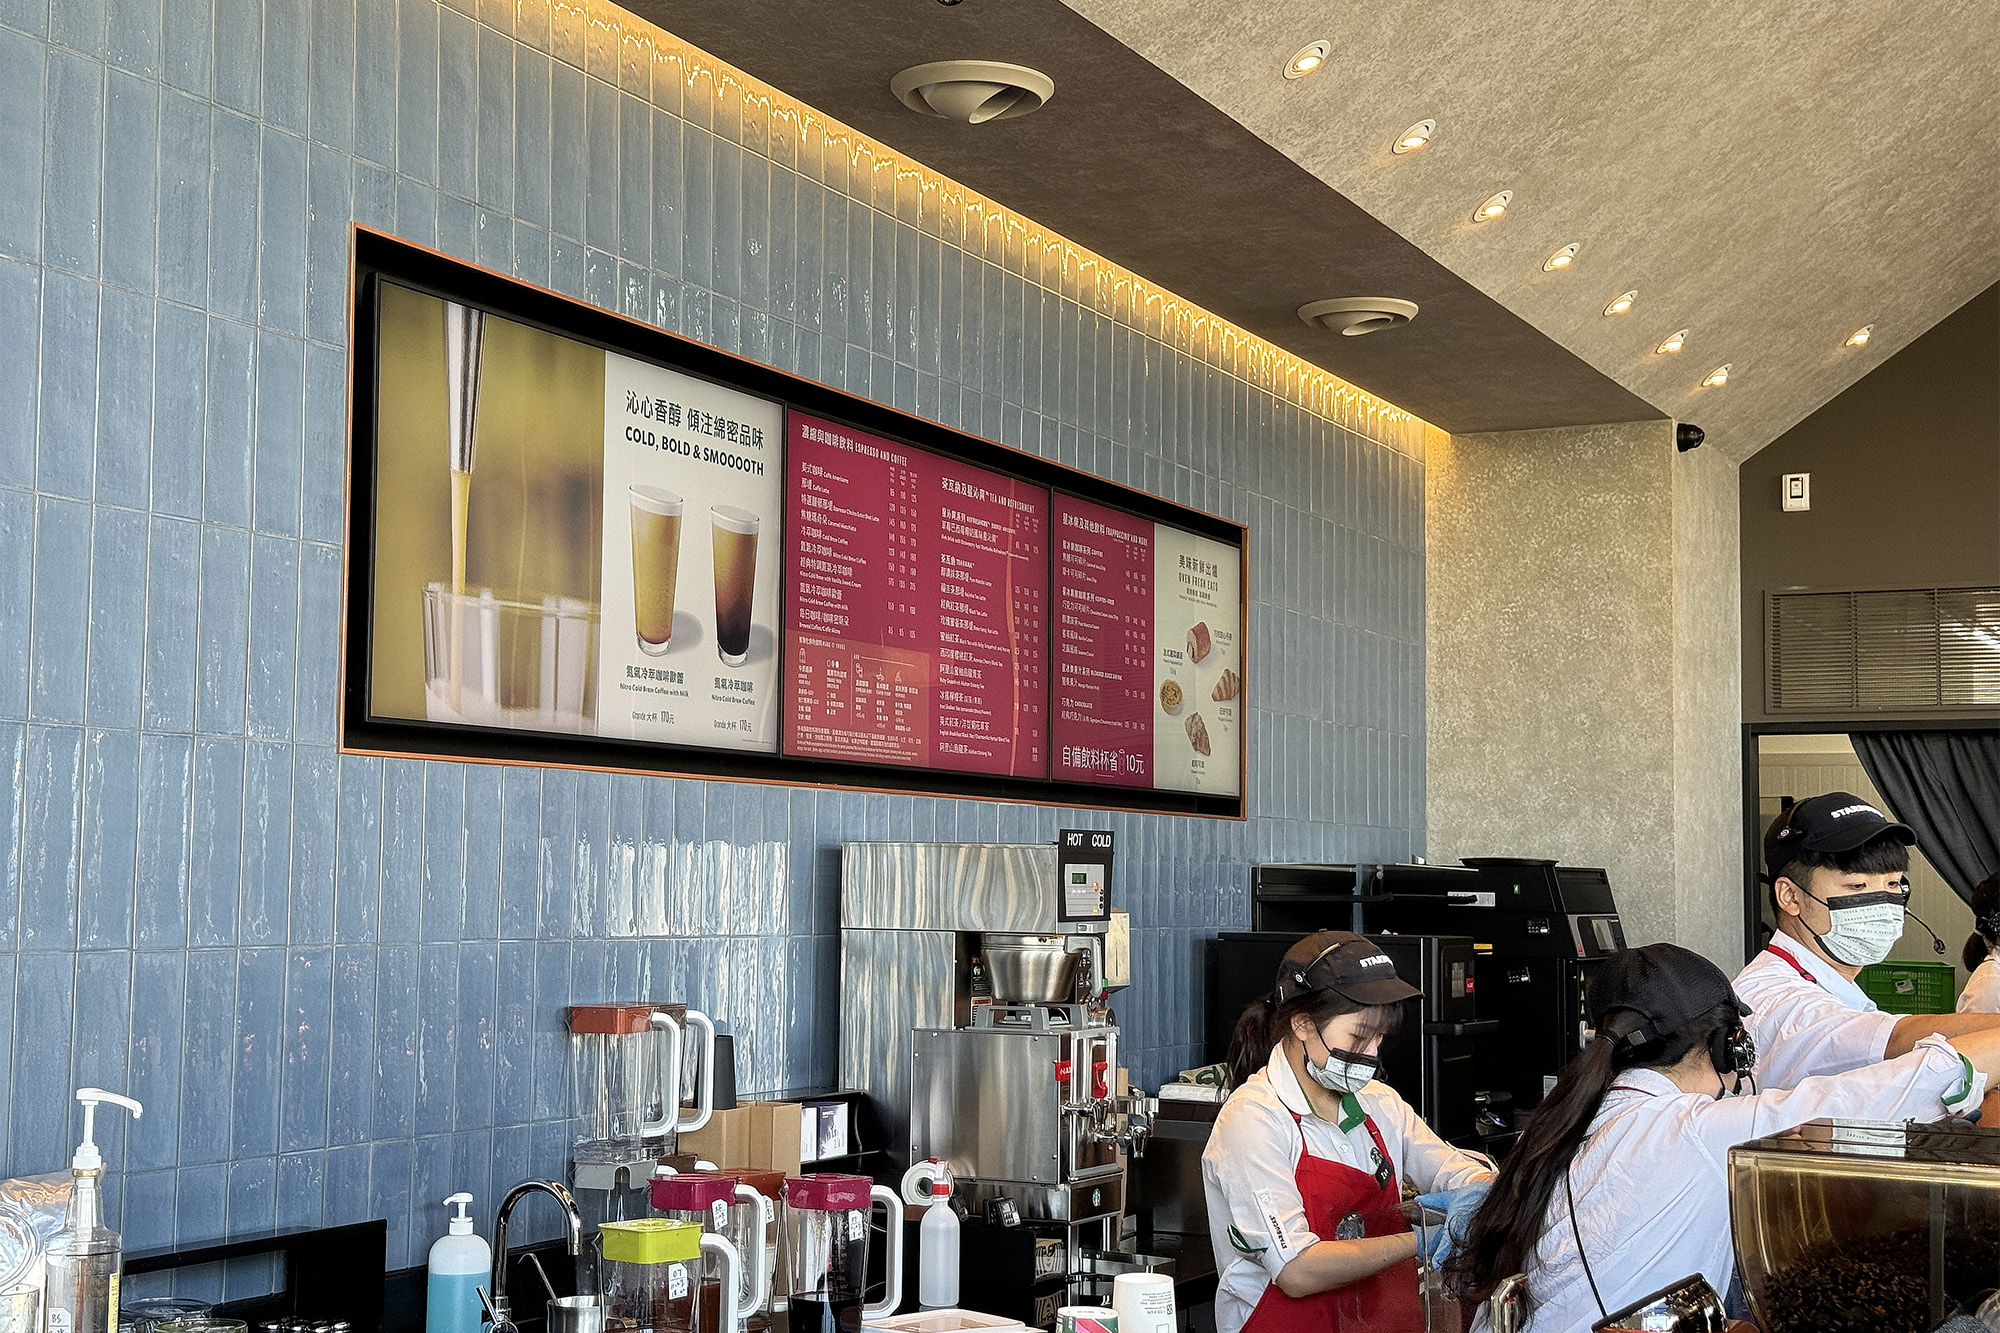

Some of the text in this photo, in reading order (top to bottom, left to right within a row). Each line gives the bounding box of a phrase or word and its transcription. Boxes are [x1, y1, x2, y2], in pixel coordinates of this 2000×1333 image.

[626, 390, 764, 450] 沁心香醇 傾注綿密品味
[626, 426, 764, 476] COLD, BOLD & SMOOOOTH
[855, 442, 879, 459] ESPRESSO
[880, 450, 890, 462] AND
[890, 453, 908, 467] COFFEE
[998, 495, 1007, 506] AND
[1007, 498, 1035, 514] REFRESHMENT
[1179, 554, 1218, 578] 美味新鮮出爐
[1179, 572, 1218, 592] OVEN FRESH EATS
[646, 712, 658, 722] 大杯
[1062, 745, 1145, 774] 自備飲料杯省 10元
[1067, 833, 1111, 848] HOT COLD
